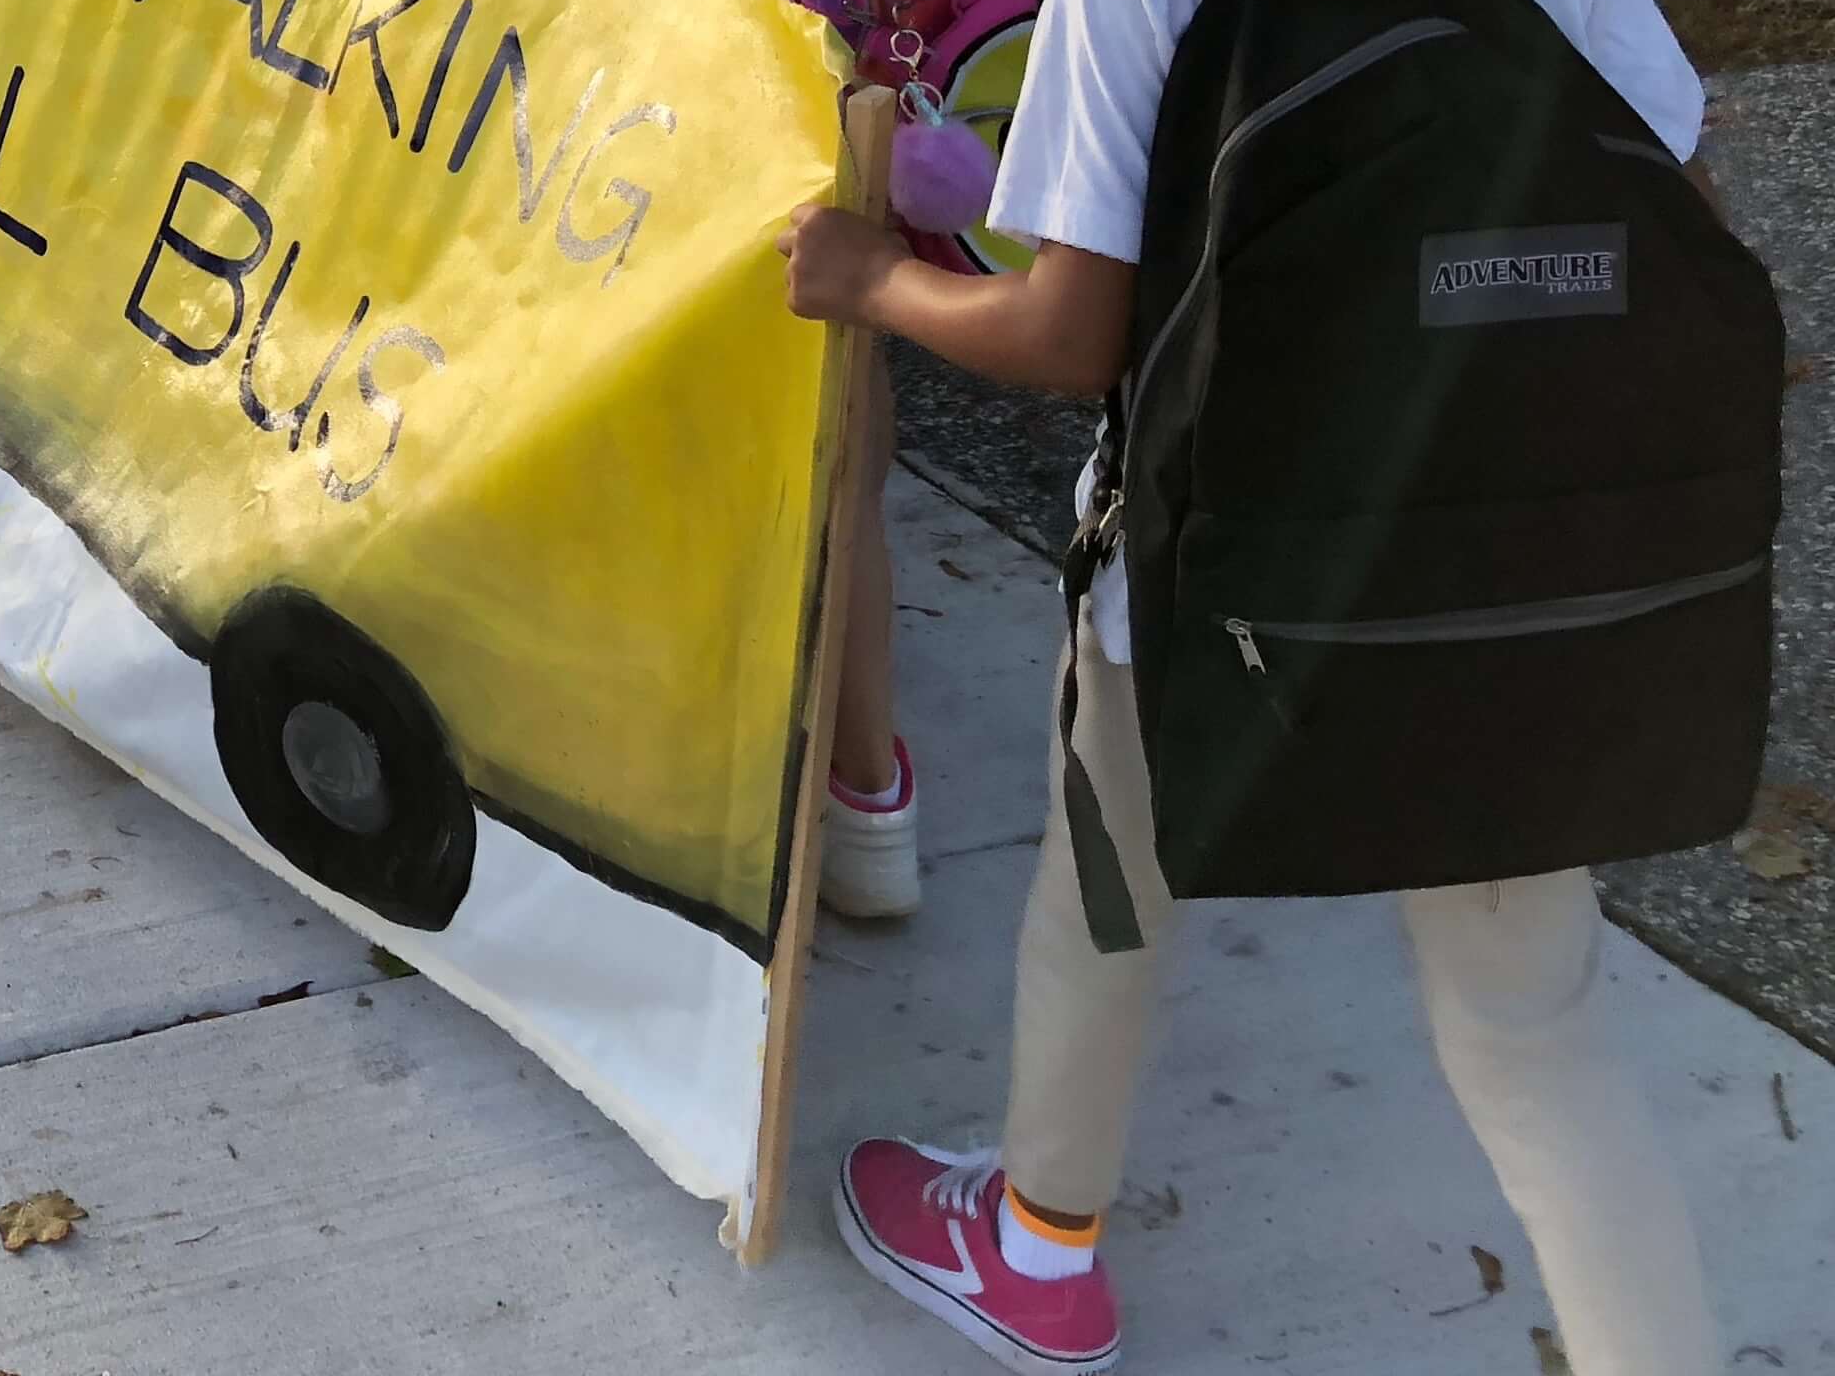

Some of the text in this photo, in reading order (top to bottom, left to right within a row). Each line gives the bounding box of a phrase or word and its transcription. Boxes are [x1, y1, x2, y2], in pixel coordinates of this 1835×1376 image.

[1430, 251, 1614, 294] ADVENTURE
[1547, 279, 1613, 294] TRAILS
[124, 160, 446, 503] BUS
